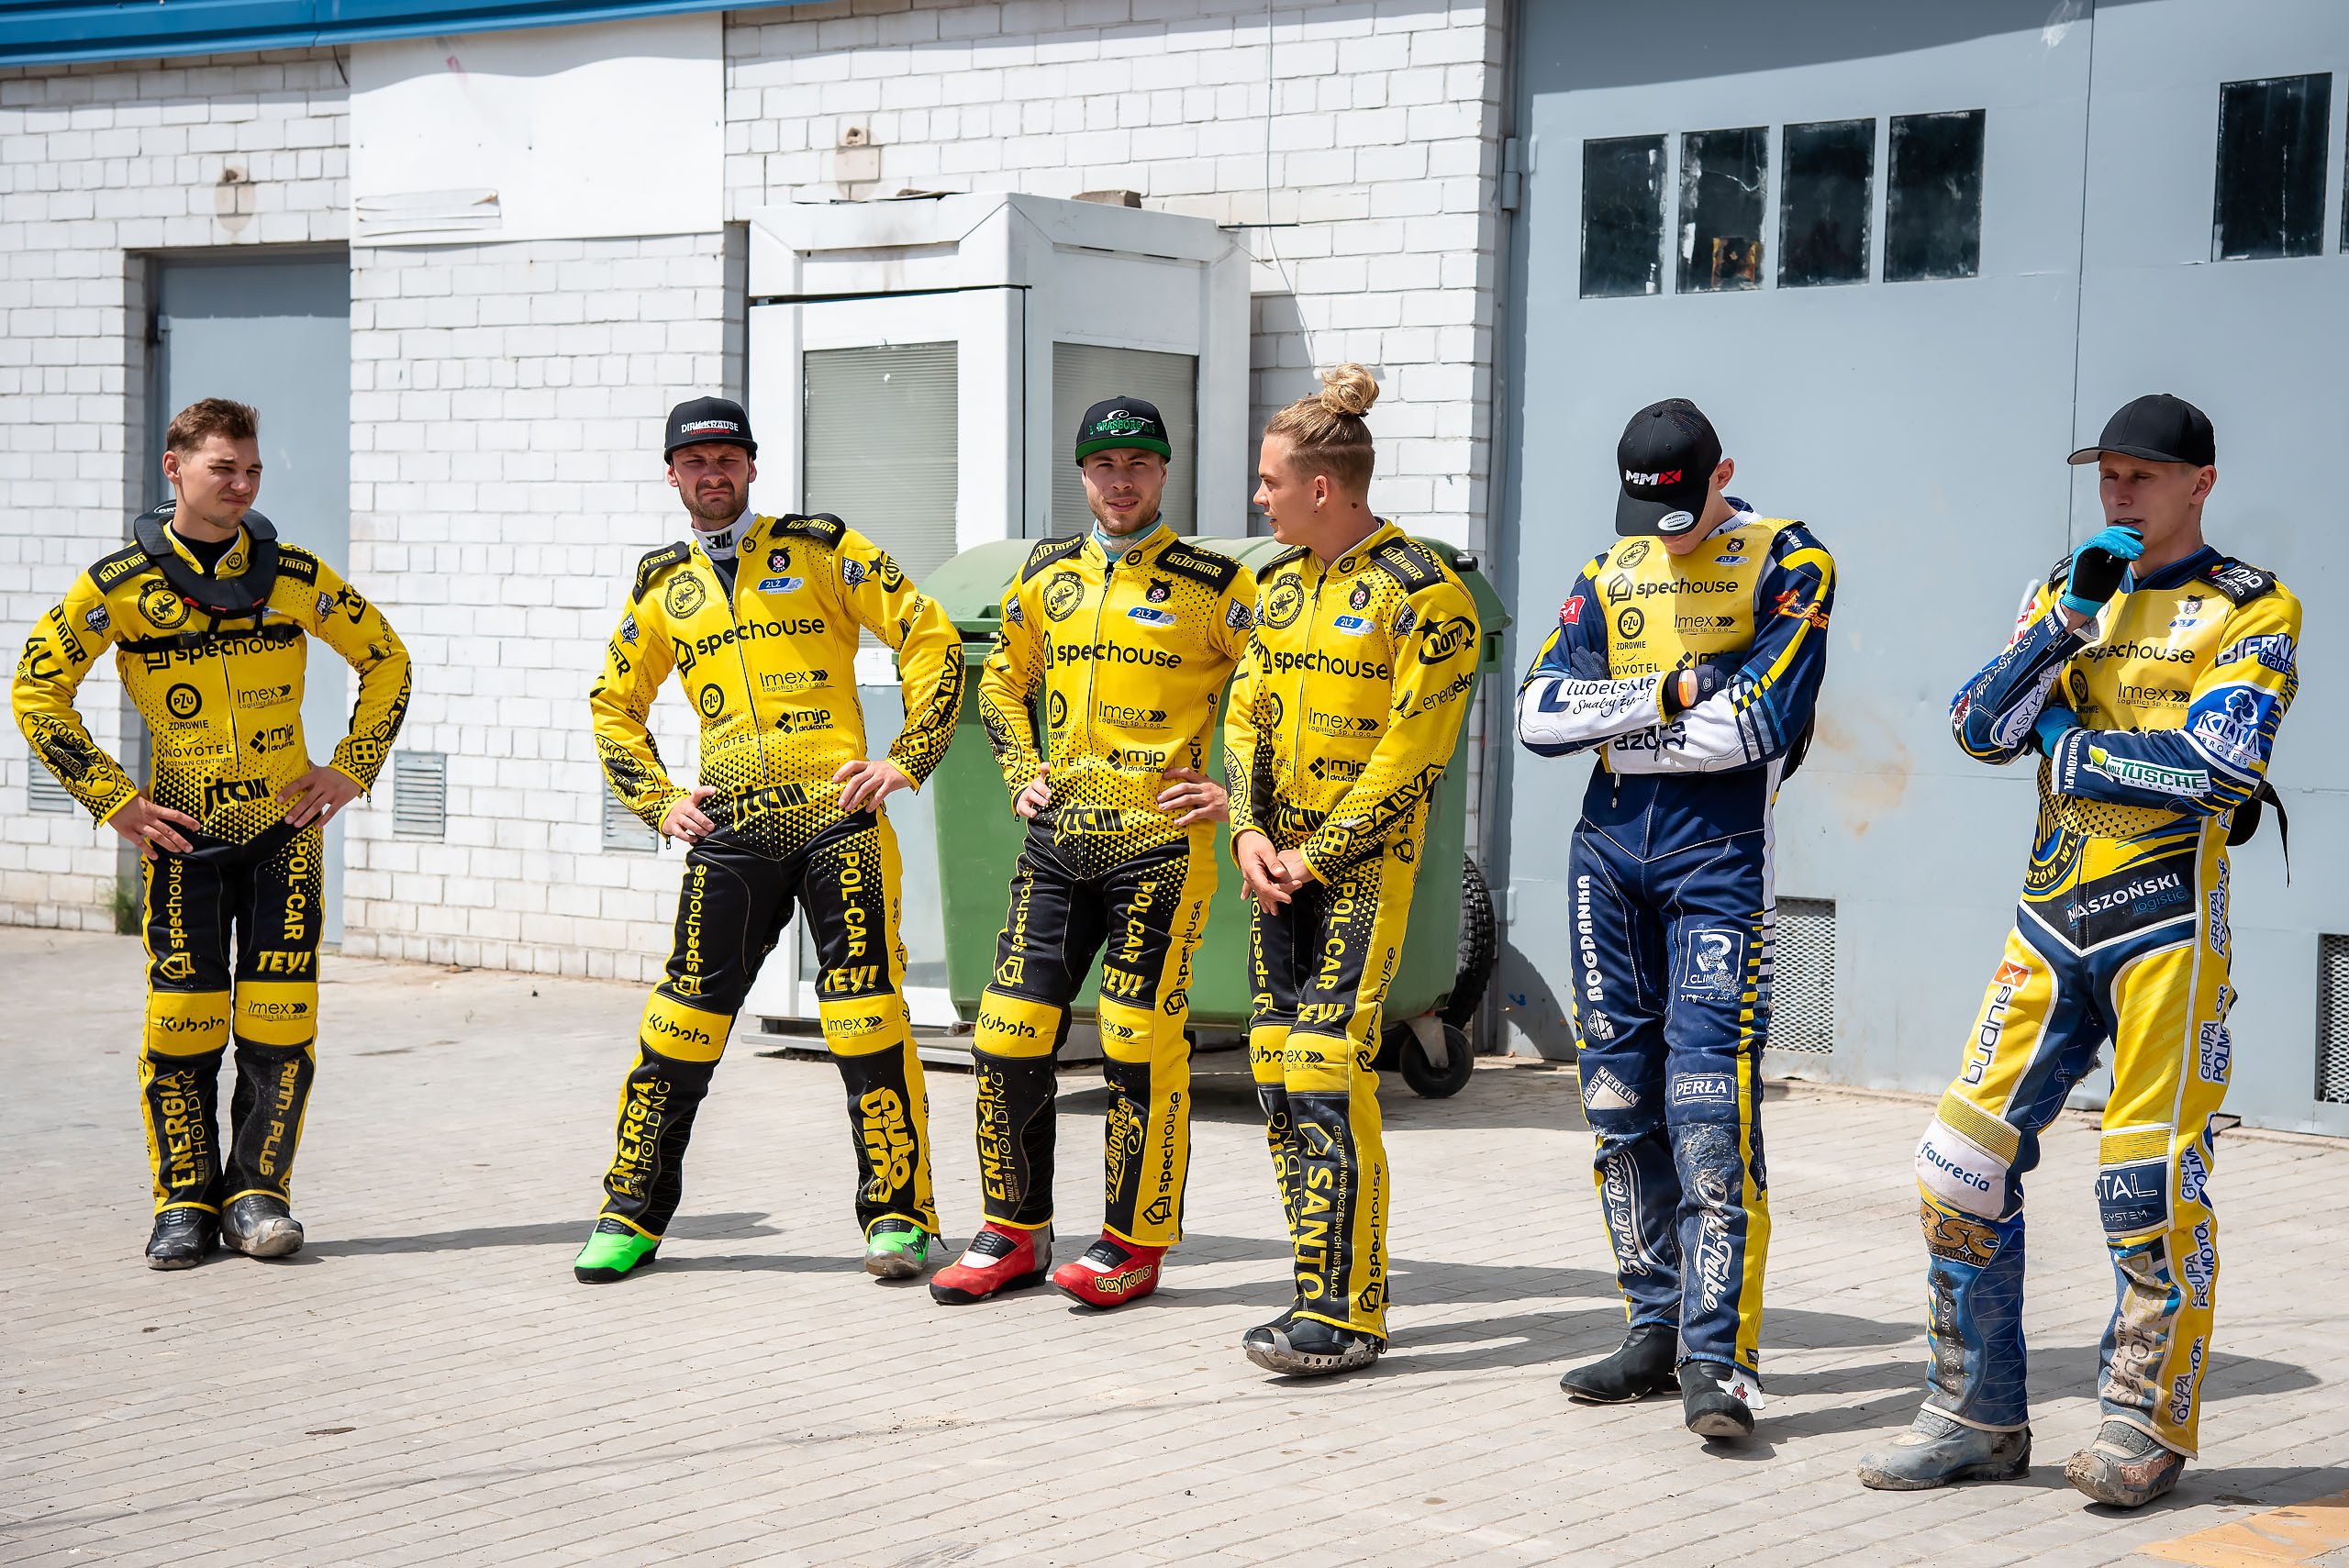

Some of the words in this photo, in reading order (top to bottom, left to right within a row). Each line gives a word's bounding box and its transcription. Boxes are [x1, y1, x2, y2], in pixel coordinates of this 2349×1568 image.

[1030, 535, 1082, 568] BUDMAR
[1379, 546, 1425, 582] BUDMAR
[1165, 551, 1223, 579] BUDMAR
[1636, 578, 1739, 599] spechouse
[2227, 567, 2264, 589] mjp
[1135, 608, 1153, 619] 2LŻ
[1351, 602, 1364, 611] PZM
[1340, 617, 1355, 628] 2LŻ
[1623, 616, 1639, 630] PZU
[1674, 614, 1714, 628] Imex
[696, 618, 826, 656] spechouse
[1430, 623, 1464, 655] LOTTO
[1616, 640, 1647, 651] ZDROWIE
[23, 637, 64, 680] 4U
[1057, 640, 1183, 669] spechouse
[2084, 639, 2196, 664] spechouse
[2259, 650, 2292, 674] trans
[1274, 649, 1389, 681] spechouse
[1610, 662, 1661, 676] NOVOTEL
[760, 671, 807, 687] Imex
[763, 684, 794, 693] Logistics
[920, 643, 962, 730] SALVA
[173, 694, 194, 709] PZU
[237, 686, 279, 705] Imex
[704, 693, 719, 709] PZU
[2117, 698, 2151, 706] Logistics
[2118, 682, 2168, 703] Imex
[796, 708, 831, 724] mjp
[1098, 717, 1129, 727] Logistics
[1099, 700, 1147, 722] Imex
[1308, 707, 1354, 730] Imex
[169, 719, 209, 731] ZDROWIE
[271, 723, 295, 741] mjp
[798, 723, 834, 731] drukarnia
[1308, 725, 1336, 734] Logistics
[165, 744, 233, 758] NOVOTEL
[705, 733, 753, 758] NOVOTEL
[1127, 750, 1166, 766] mjp
[196, 758, 233, 766] CENTRUM
[2120, 762, 2207, 790] TUSCHE
[1352, 762, 1446, 838] SALVA
[284, 841, 310, 940] POL-CAR
[2133, 887, 2186, 913] logistic
[166, 858, 189, 950] spechouse
[838, 850, 867, 958] POL-CAR
[1011, 865, 1036, 952] spechouse
[685, 863, 707, 973] spechouse
[1119, 881, 1158, 963] POL-CAR
[1316, 882, 1358, 991] POL-CAR
[1576, 873, 1604, 1003] BOGDANKA
[249, 999, 289, 1016] Imex
[161, 1015, 226, 1033] Kubota
[650, 1012, 712, 1046] Kubota
[827, 1017, 863, 1032] Imex
[979, 1012, 1038, 1040] Kubota
[2201, 1022, 2218, 1081] GRUPA
[1598, 1067, 1640, 1105] MERLIN
[1675, 1079, 1728, 1095] PERŁA
[992, 1072, 1015, 1171] HOLDING
[259, 1120, 285, 1177] PLUS
[1159, 1091, 1182, 1194] spechouse
[1333, 1124, 1346, 1168] CENTRUM
[1920, 1140, 1991, 1193] faurecia
[1332, 1170, 1348, 1252] NOWOCZESNYCH
[2103, 1209, 2148, 1222] SYSTEM
[1295, 1164, 1334, 1301] SANTO
[1093, 1264, 1153, 1296] daytona
[1330, 1253, 1341, 1303] INSTALACJI
